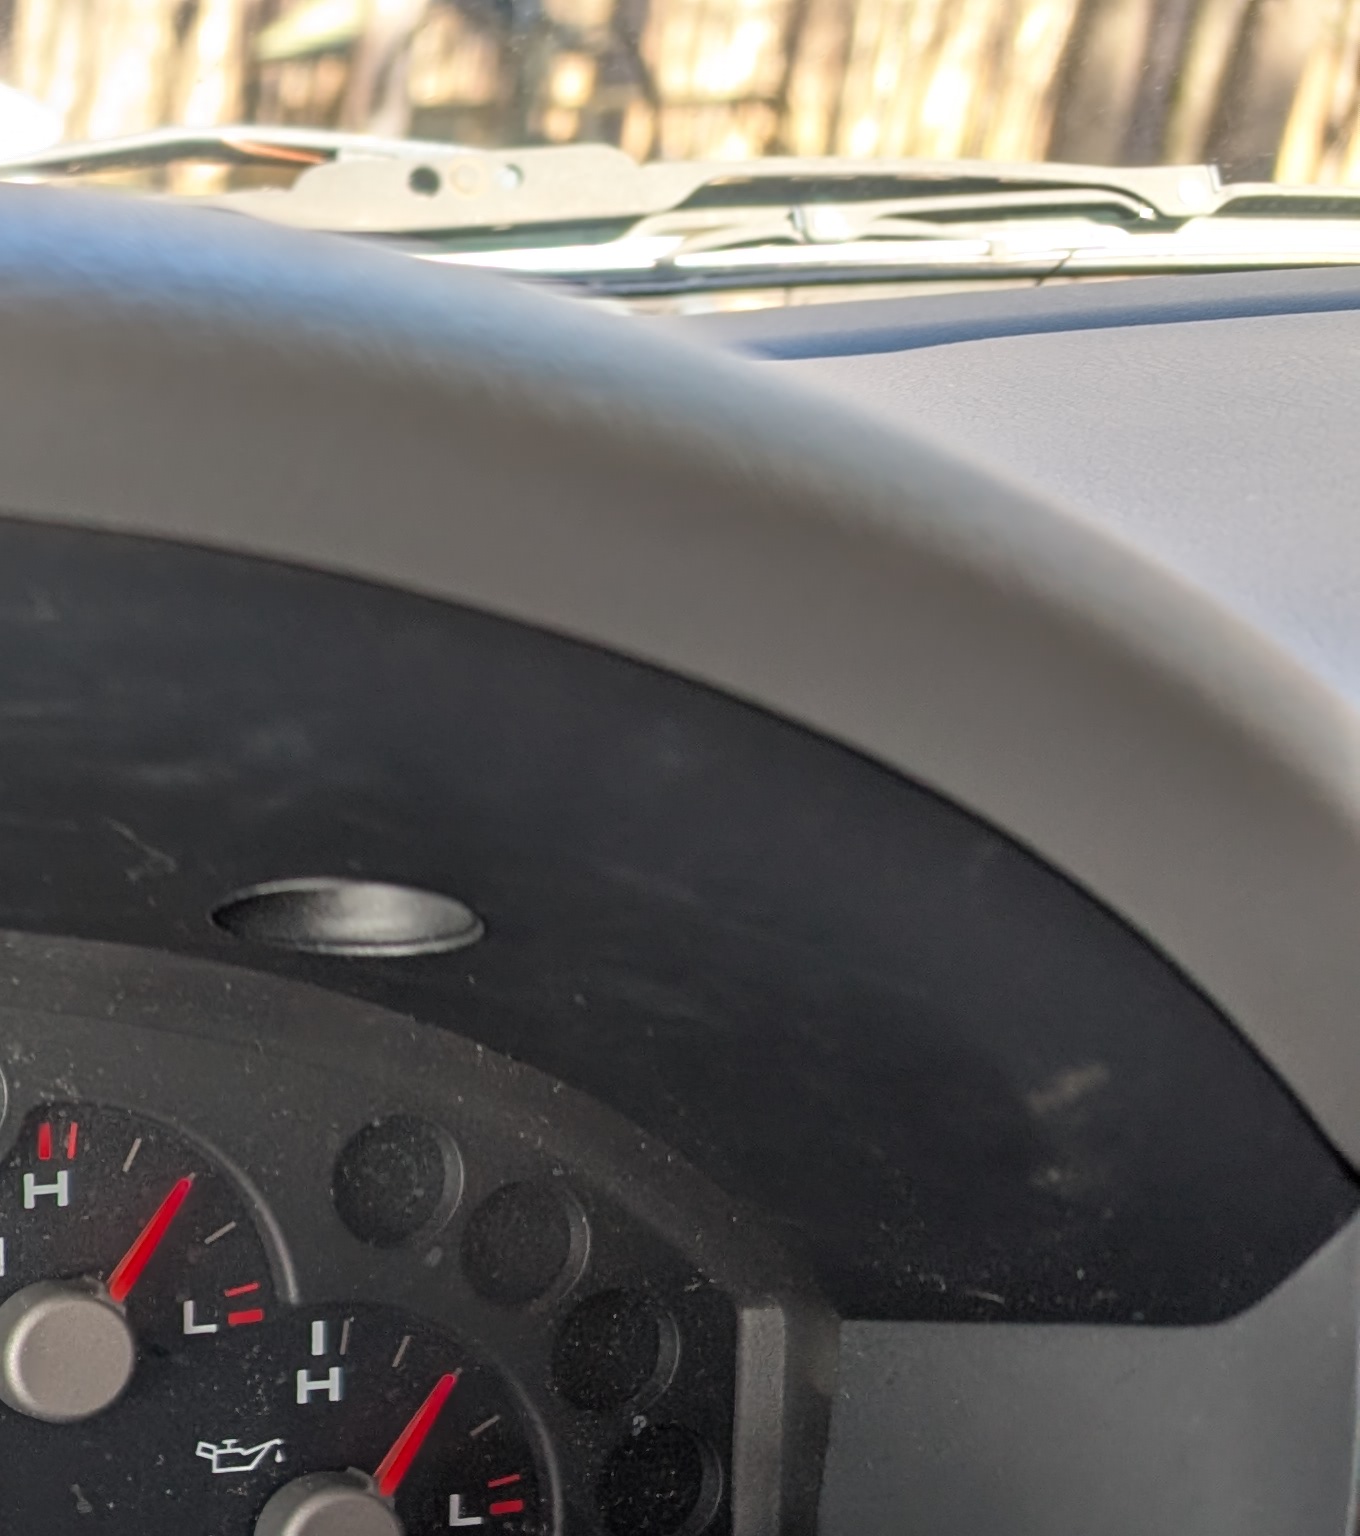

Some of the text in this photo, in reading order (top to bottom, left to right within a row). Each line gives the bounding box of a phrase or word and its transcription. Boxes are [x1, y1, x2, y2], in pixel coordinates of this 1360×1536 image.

[23, 1170, 69, 1209] H
[183, 1300, 218, 1335] L
[296, 1366, 341, 1405] H
[449, 1493, 483, 1527] L
